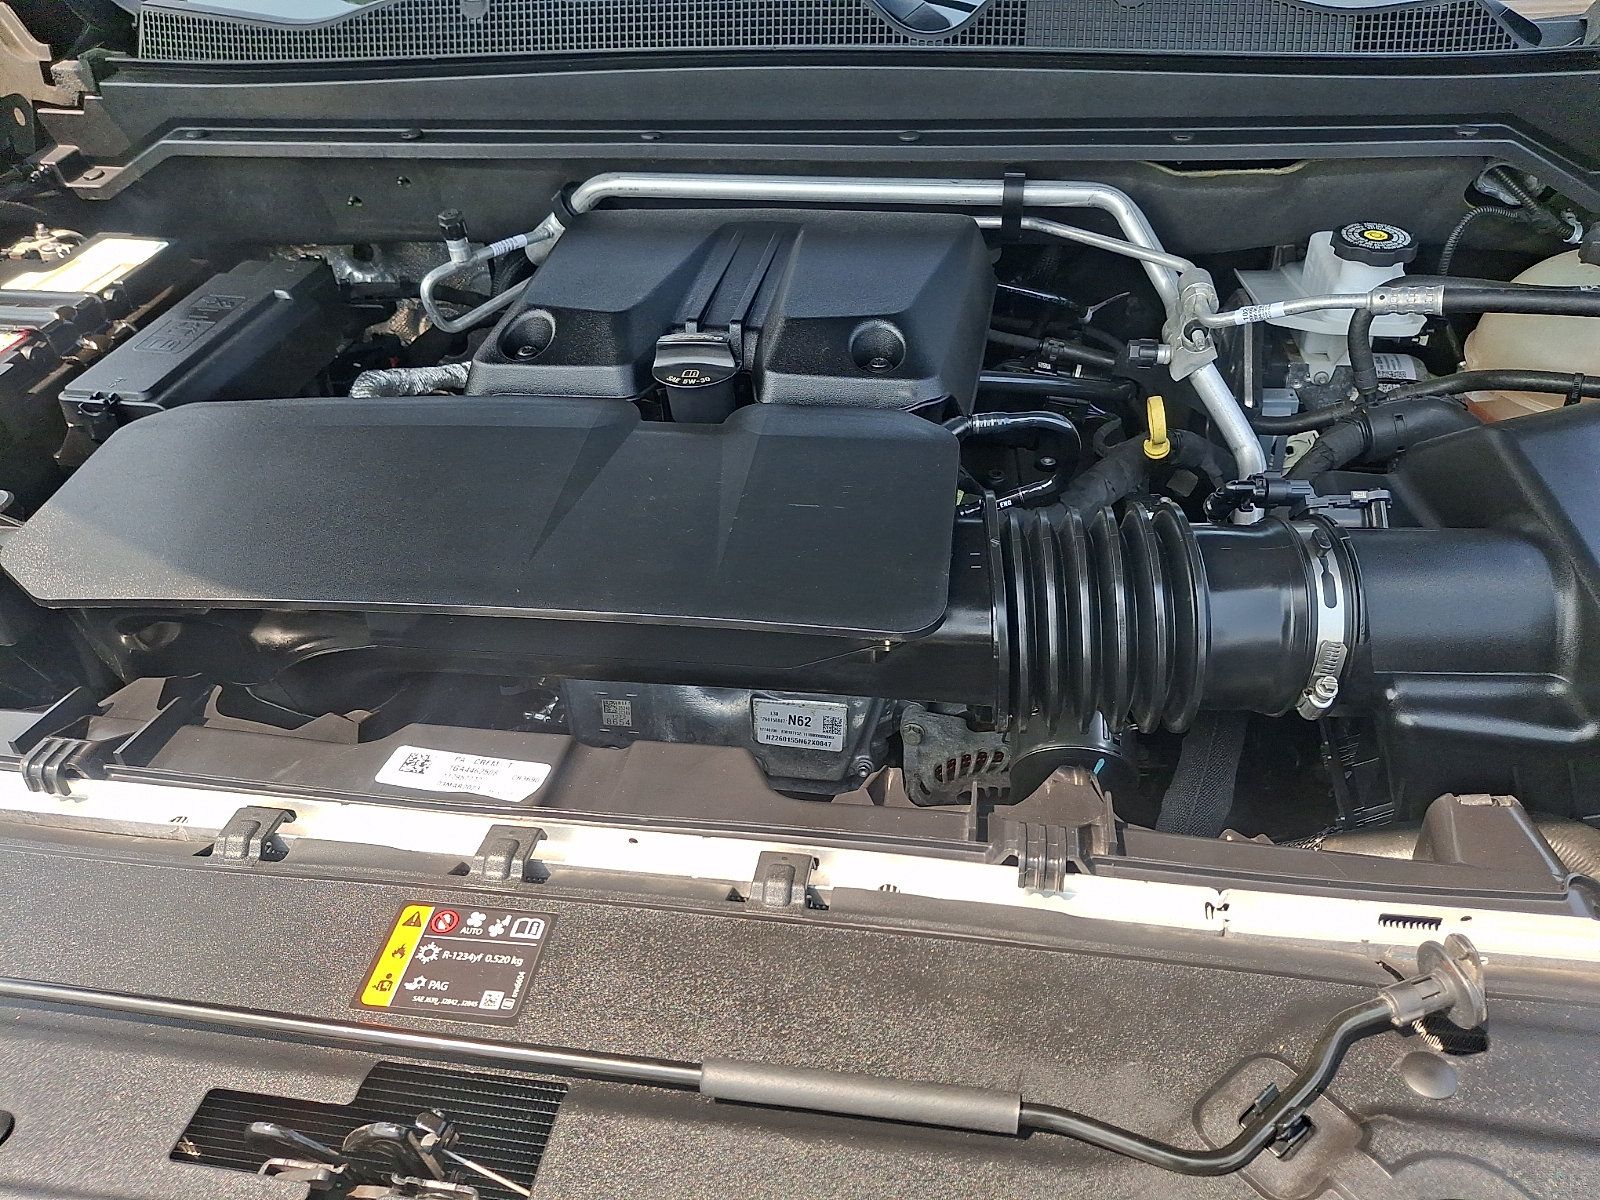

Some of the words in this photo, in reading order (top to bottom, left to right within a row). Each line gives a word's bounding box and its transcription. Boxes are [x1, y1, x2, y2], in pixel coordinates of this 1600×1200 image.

[666, 375, 680, 383] SAE
[787, 714, 812, 728] N62
[460, 927, 483, 936] AUTO
[442, 951, 483, 963] R-1234yf
[484, 954, 511, 965] 0.520
[511, 957, 524, 967] kg
[428, 980, 450, 991] PAG
[411, 995, 424, 1003] SAE
